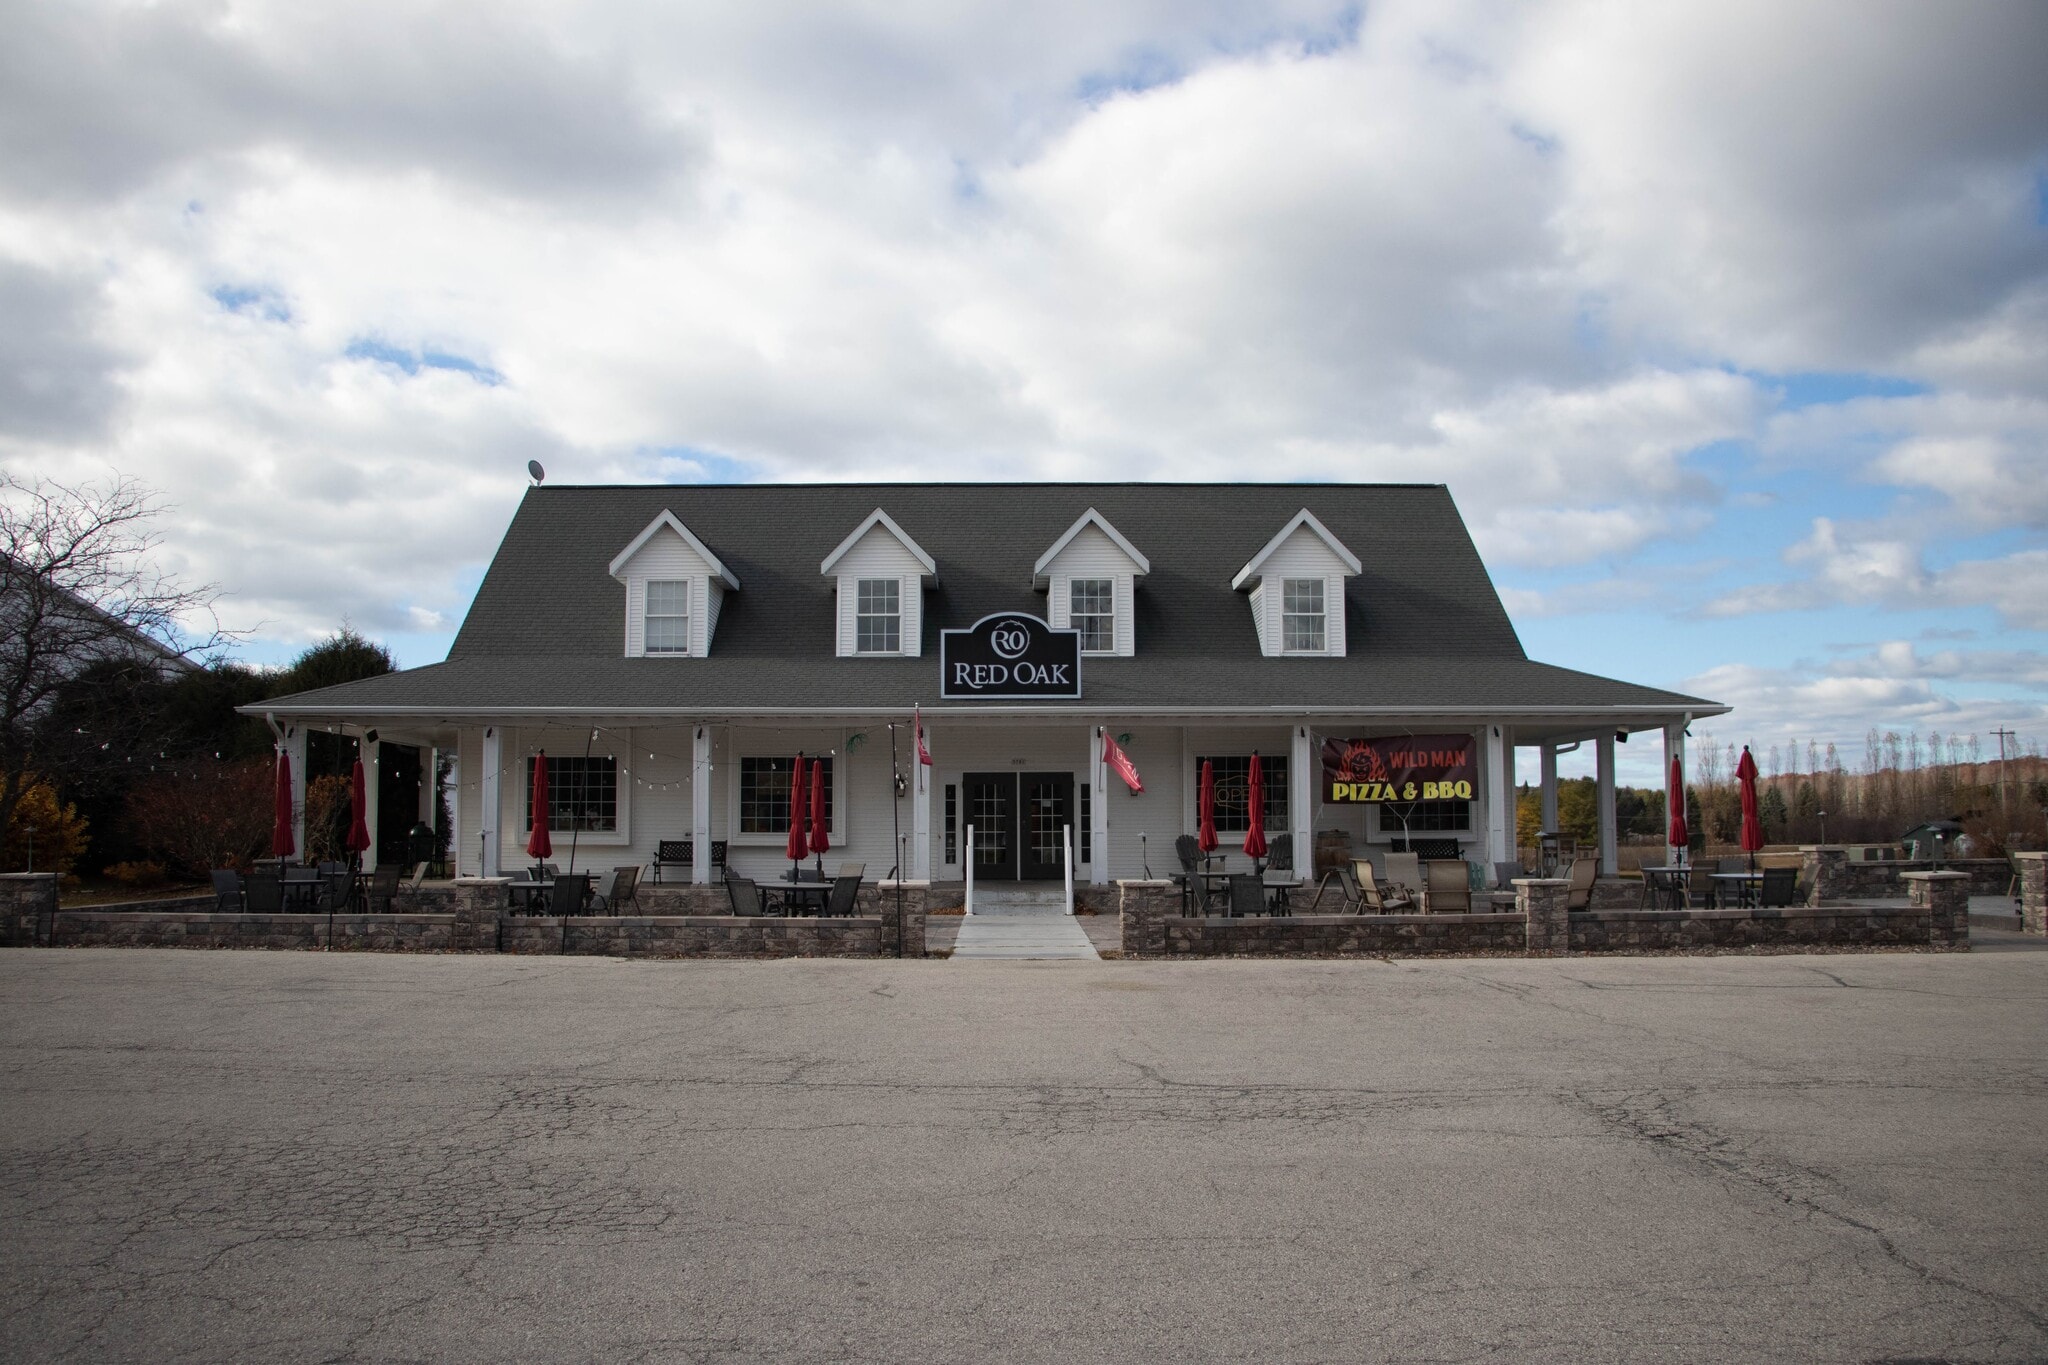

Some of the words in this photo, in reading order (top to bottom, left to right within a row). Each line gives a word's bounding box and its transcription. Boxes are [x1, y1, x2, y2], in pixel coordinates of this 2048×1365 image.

[954, 662, 1008, 689] RED
[1013, 661, 1070, 684] OAK
[1389, 751, 1428, 769] WILD
[1431, 750, 1467, 768] MAN
[1217, 788, 1264, 802] OPE
[1332, 782, 1398, 801] PIZZA
[1402, 781, 1418, 800] &
[1423, 780, 1472, 800] BBQ
